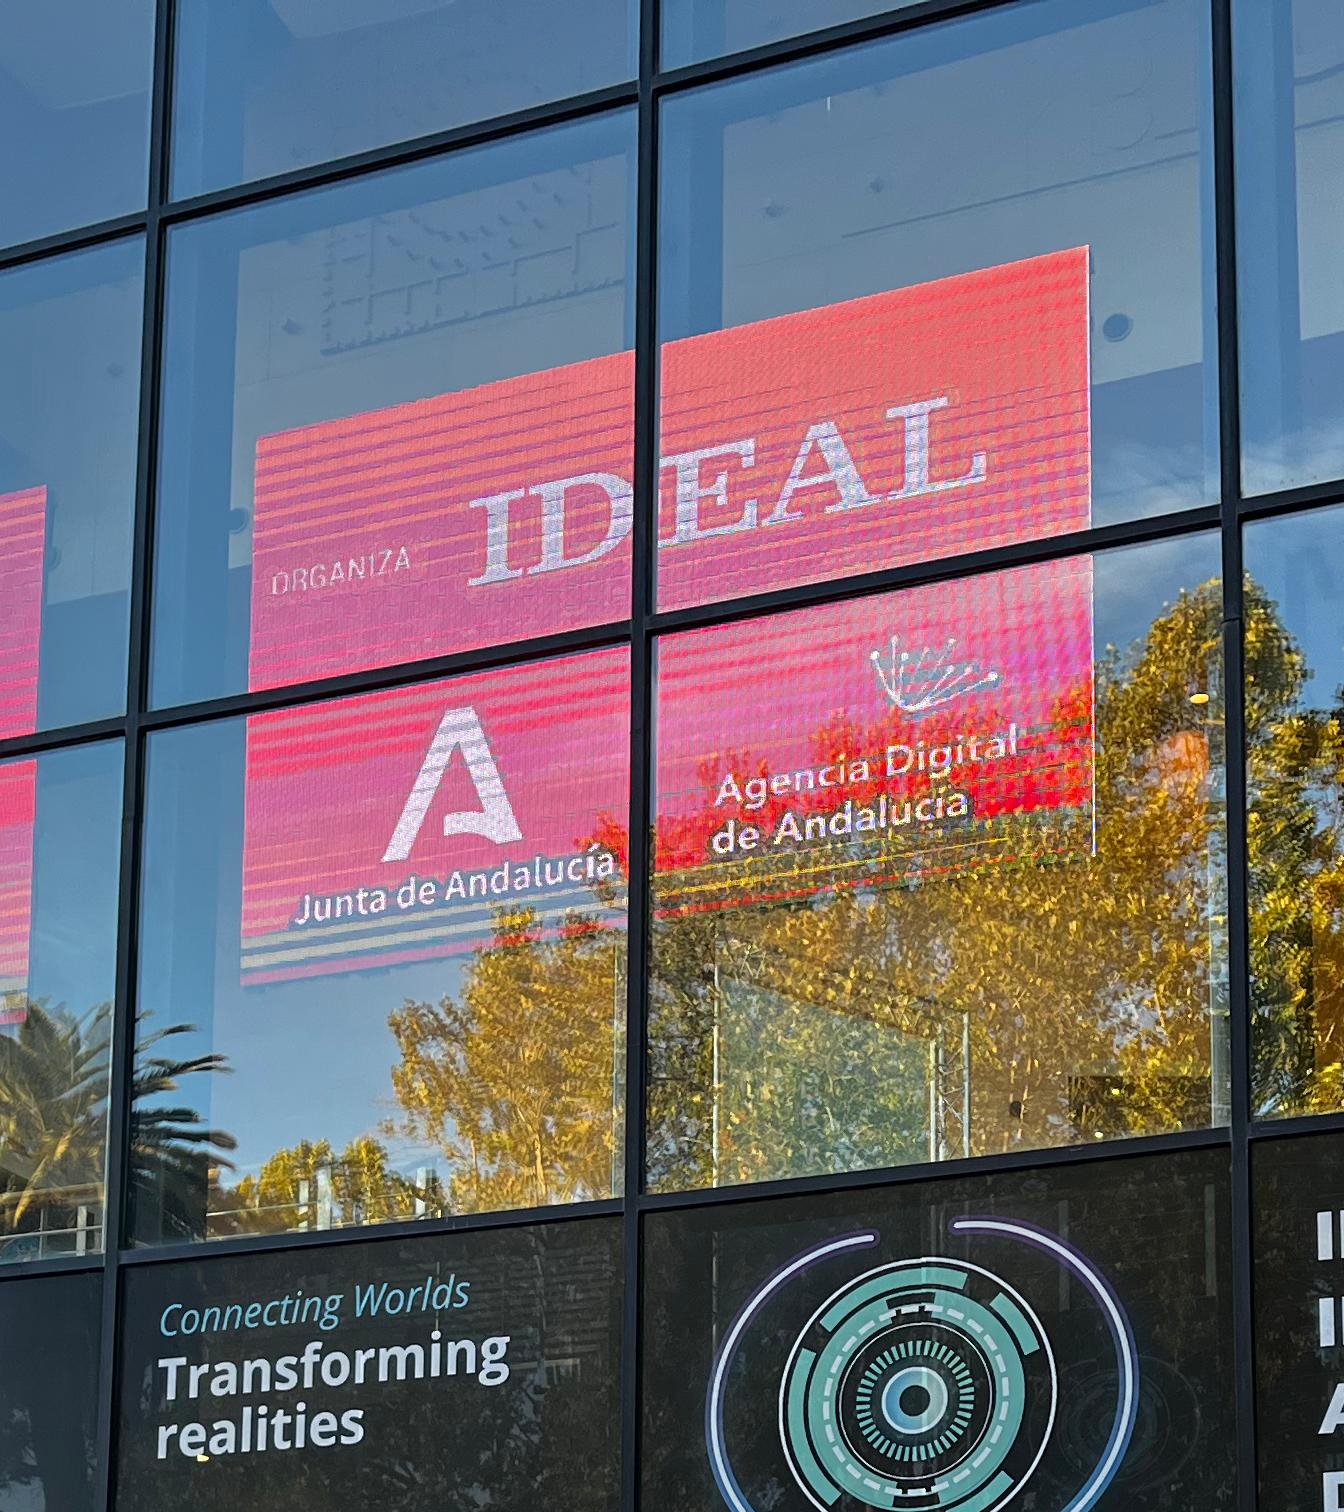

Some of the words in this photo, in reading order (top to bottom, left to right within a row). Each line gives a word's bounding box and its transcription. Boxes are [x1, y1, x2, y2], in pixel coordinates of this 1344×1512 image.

[468, 396, 988, 588] IDEAL
[271, 546, 412, 596] ORGANIZA
[714, 753, 870, 810] Agencia
[886, 722, 1018, 780] Digital
[711, 819, 760, 854] de
[773, 785, 968, 846] Andalucía
[294, 887, 388, 926] Junta
[396, 877, 436, 910] de
[444, 842, 615, 902] Andalucía
[159, 1289, 344, 1337] Connecting
[354, 1273, 471, 1318] Worlds
[158, 1329, 511, 1401] Transforming
[157, 1401, 365, 1460] realities
